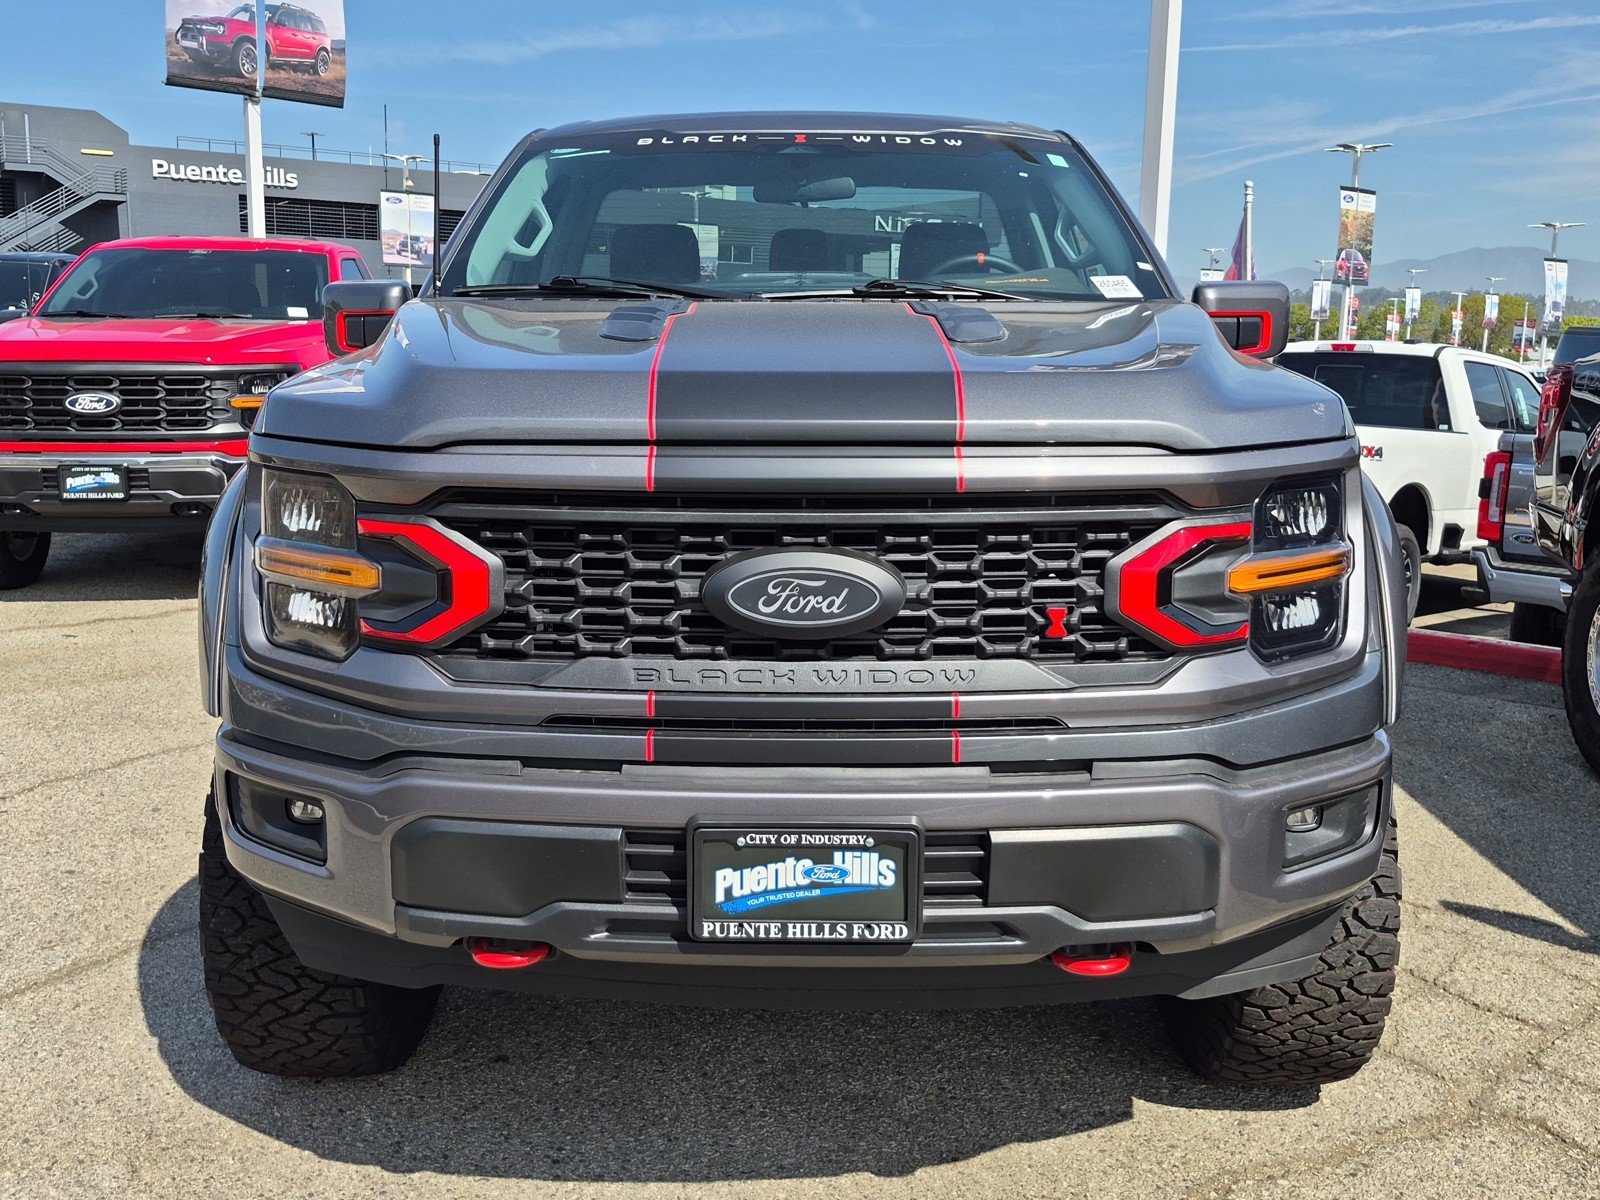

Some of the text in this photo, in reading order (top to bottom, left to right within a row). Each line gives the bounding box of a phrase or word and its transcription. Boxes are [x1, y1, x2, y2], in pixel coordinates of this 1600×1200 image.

[637, 134, 963, 147] BLACK WIDOW
[152, 159, 298, 187] Puente ills
[75, 396, 107, 410] Ford
[757, 577, 849, 614] Ford
[632, 667, 976, 686] BLACK WIDOW
[746, 833, 867, 846] CITY OF INDUSTRY
[714, 850, 896, 904] Puente Hills
[810, 866, 841, 880] Ford
[746, 889, 821, 906] YOUR TRUSTED DEALER
[702, 922, 908, 939] PUENTE HILLS FORD
